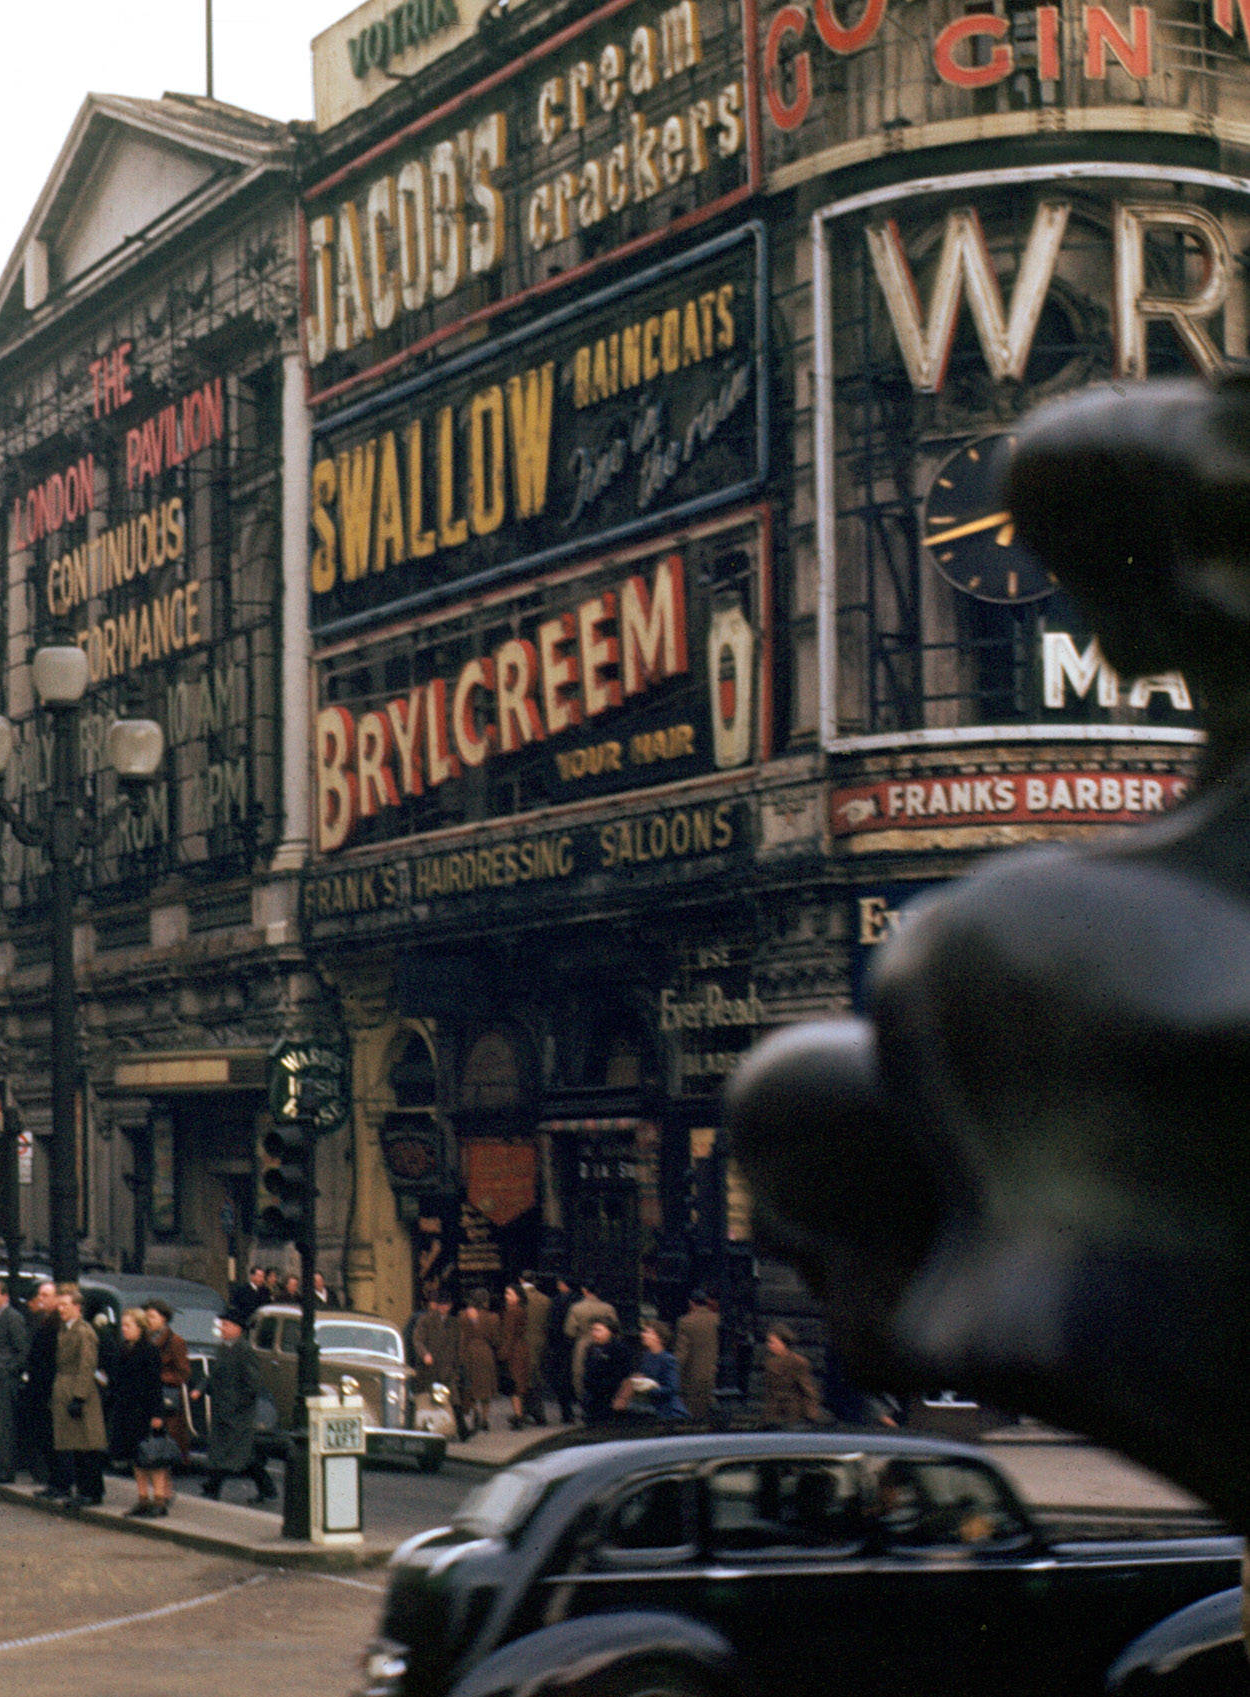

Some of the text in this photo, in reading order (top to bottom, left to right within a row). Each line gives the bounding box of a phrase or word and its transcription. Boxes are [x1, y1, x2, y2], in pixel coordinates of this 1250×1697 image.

[538, 0, 702, 145] cream
[935, 5, 1151, 88] GIN
[528, 82, 744, 251] crackers
[865, 201, 1228, 394] WR
[89, 342, 133, 419] THE
[311, 361, 554, 594] SWALLOW
[573, 284, 735, 410] RAINCOATS
[14, 377, 222, 551] LONDON PAVILION
[47, 496, 184, 616] CONTINUOUS
[317, 554, 688, 852] BRYLCREEM
[415, 836, 574, 898] HAIRDRESSING
[600, 804, 735, 868] SALOONS
[887, 776, 1016, 817] FRANK'S
[1026, 777, 1163, 812] BARBER
